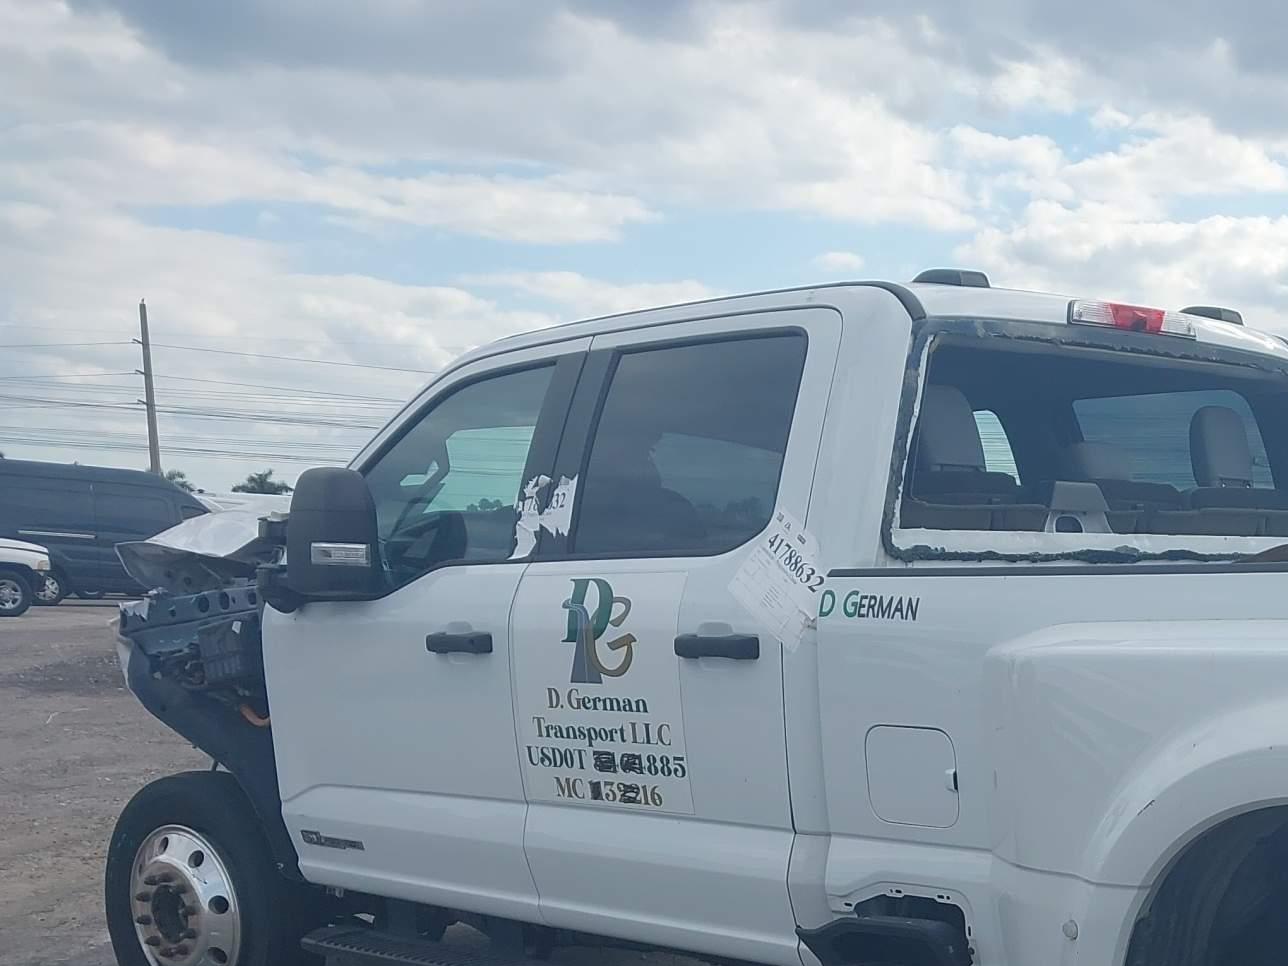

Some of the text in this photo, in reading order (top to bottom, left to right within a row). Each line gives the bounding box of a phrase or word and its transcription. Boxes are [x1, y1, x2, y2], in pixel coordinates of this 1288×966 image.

[768, 533, 825, 593] 41788632
[818, 588, 836, 617] D
[547, 687, 649, 714] D. German
[532, 716, 671, 747] Transport LLC
[526, 745, 586, 770] USDOT
[554, 776, 585, 799] MC
